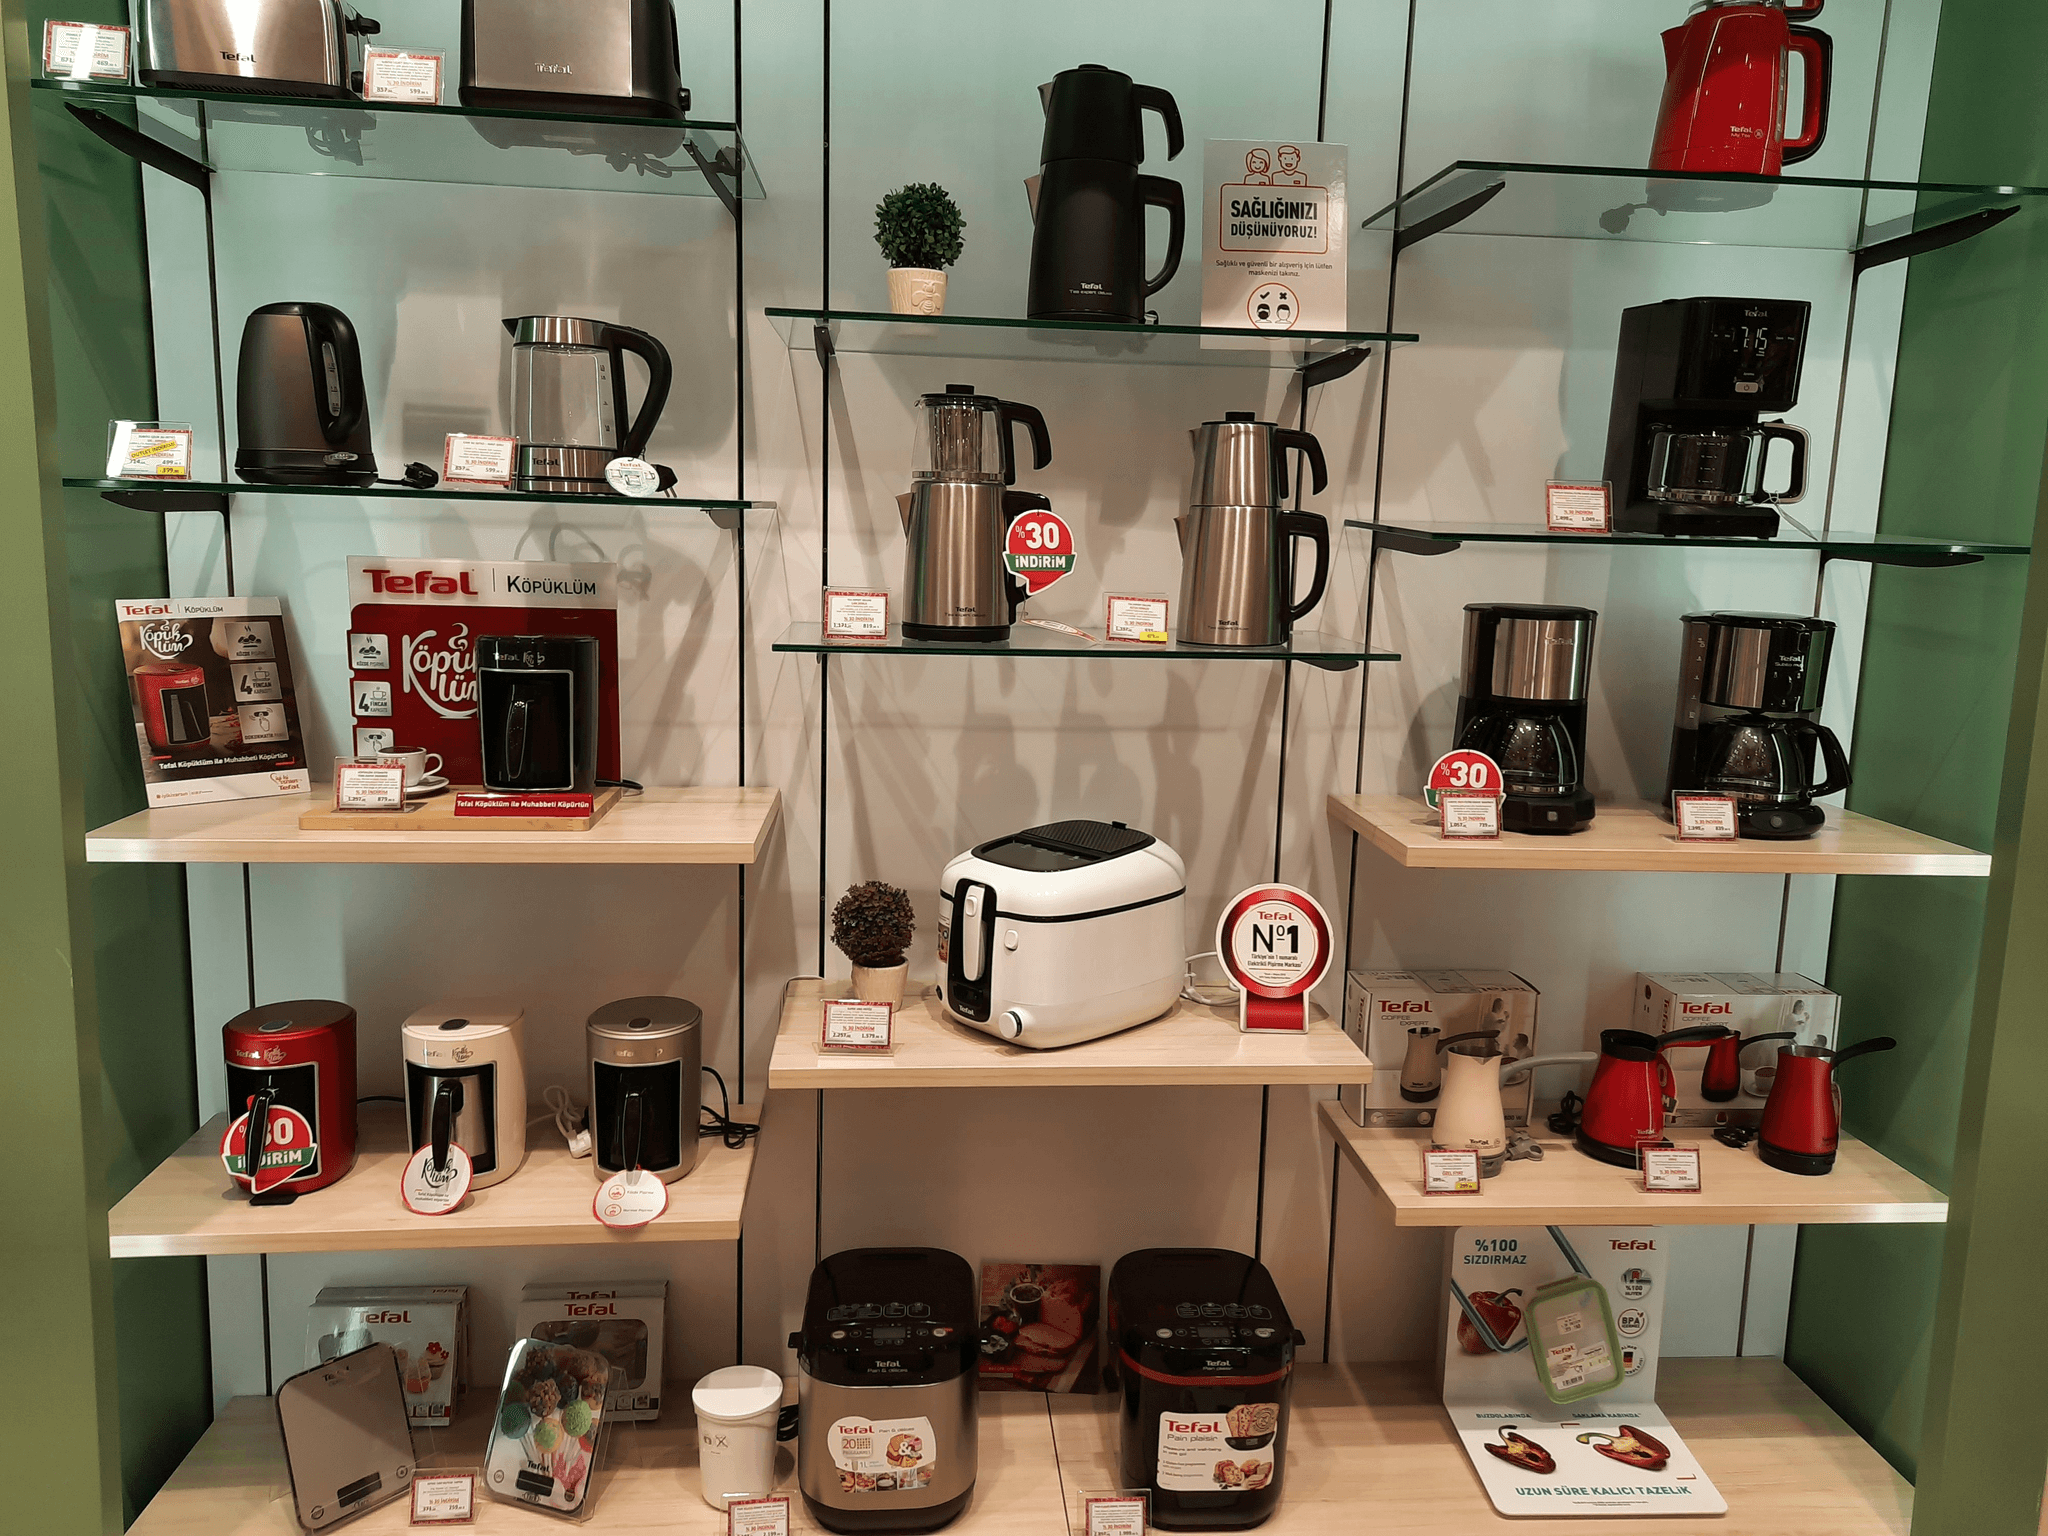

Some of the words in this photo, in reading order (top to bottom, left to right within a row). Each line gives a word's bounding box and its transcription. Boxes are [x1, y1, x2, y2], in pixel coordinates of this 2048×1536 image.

[220, 50, 256, 63] Tefal
[534, 62, 573, 75] Tefal
[1230, 196, 1318, 220] SAĞLIĞINIZI
[1230, 221, 1318, 239] DÜŞÜNÜYORUZ!
[1216, 260, 1238, 268] Sağlıklı
[1246, 260, 1268, 268] güvenli
[1744, 310, 1768, 318] Tefal
[532, 458, 560, 467] Tefal
[362, 568, 478, 596] Tefal
[507, 576, 596, 596] KÖPÜKLÜM
[122, 604, 172, 616] Tefal
[184, 605, 224, 615] KÖPÜKLÜM
[402, 630, 478, 694] Köpü
[240, 674, 252, 694] 4
[358, 693, 370, 712] 4
[158, 762, 178, 770] Tefal
[178, 760, 214, 769] Köpüklüm
[224, 755, 258, 764] Muhabbeti
[258, 752, 288, 762] Köpürtün
[1256, 910, 1295, 921] Tefal
[958, 1004, 975, 1016] Tefal
[1378, 1000, 1433, 1012] Tefal
[1678, 1002, 1733, 1014] Tefal
[236, 1049, 260, 1059] Tefal
[1474, 1239, 1518, 1252] %100
[1608, 1239, 1656, 1250] Tefal
[1464, 1255, 1527, 1264] SIZDIRMAZ
[564, 1302, 617, 1316] Tefal
[360, 1310, 412, 1324] Tefal
[1551, 1345, 1576, 1356] Tefal
[837, 1425, 874, 1434] Tefal
[1164, 1419, 1222, 1434] Tefal
[842, 1438, 856, 1450] 20
[1167, 1434, 1188, 1442] Pain
[1190, 1434, 1218, 1442] plaisir
[528, 1460, 550, 1472] Tefal
[1515, 1486, 1553, 1496] UZUN
[1556, 1484, 1588, 1496] SÜRE
[1591, 1486, 1634, 1496] KALICI
[1636, 1485, 1692, 1495] TAZELİK
